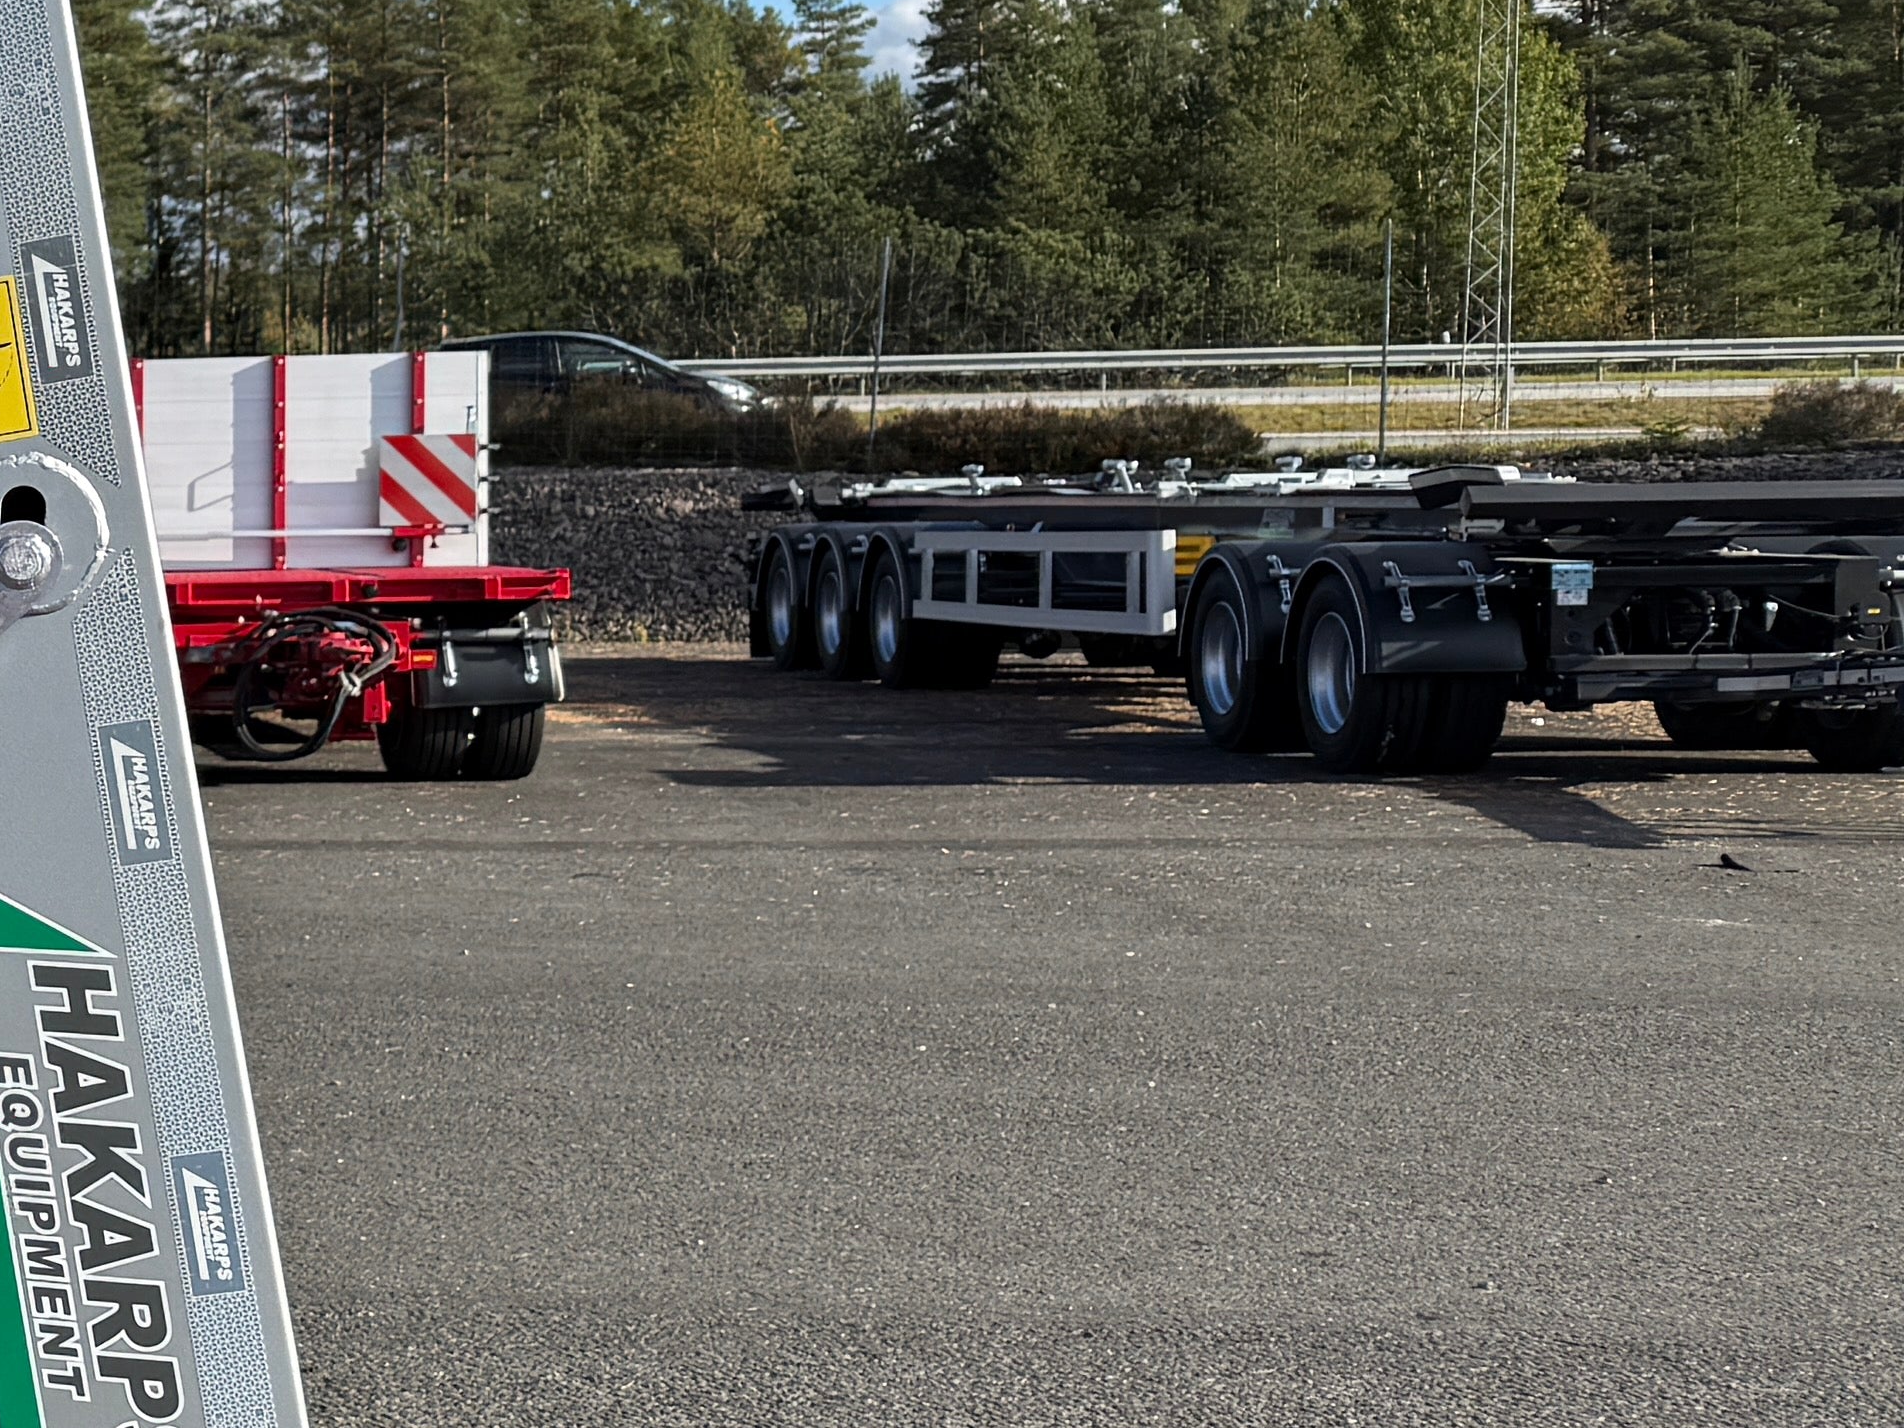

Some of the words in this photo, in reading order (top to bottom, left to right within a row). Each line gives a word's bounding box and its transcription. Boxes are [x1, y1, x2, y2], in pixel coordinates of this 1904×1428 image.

[52, 273, 82, 367] HAKARPS
[131, 757, 161, 850] HAKARPS
[203, 1187, 233, 1281] HAKARPS
